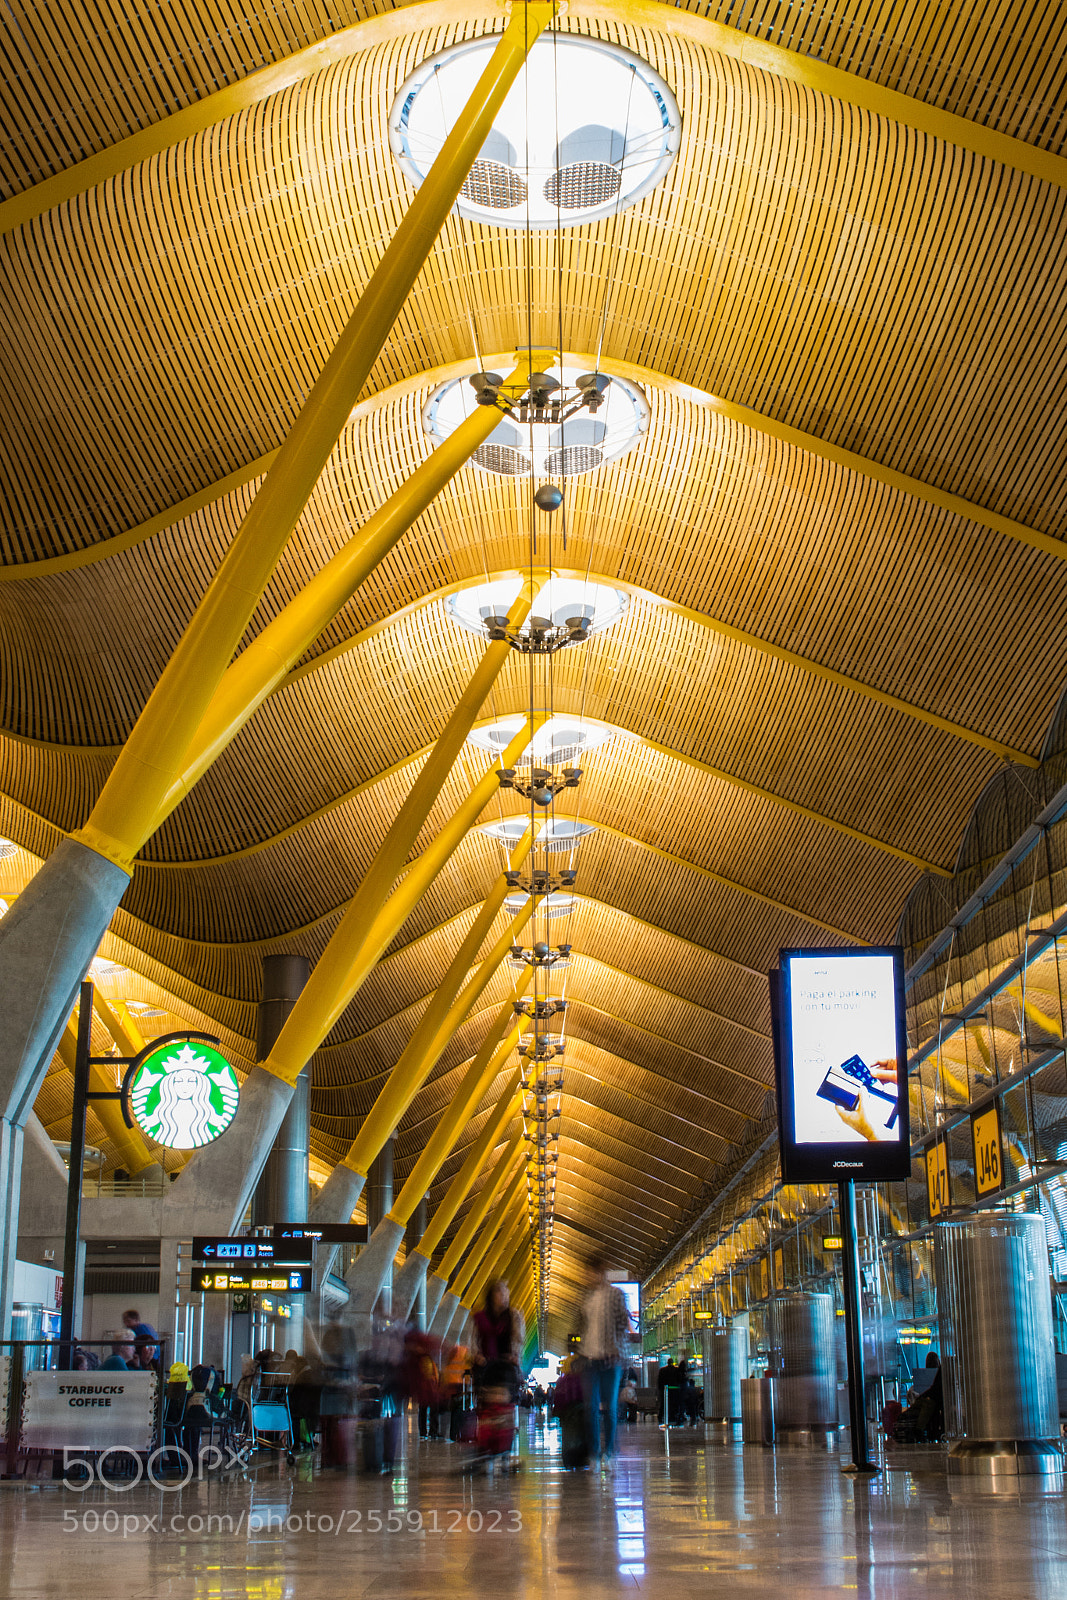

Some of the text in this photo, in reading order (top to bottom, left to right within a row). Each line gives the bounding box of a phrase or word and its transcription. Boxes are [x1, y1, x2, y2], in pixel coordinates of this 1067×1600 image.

[839, 988, 877, 999] parking
[821, 1003, 831, 1011] tu
[979, 1140, 998, 1185] J46
[931, 1169, 945, 1210] J47
[254, 1280, 266, 1288] J46
[58, 1386, 124, 1395] STARBUCKS
[68, 1398, 111, 1407] COFFEE
